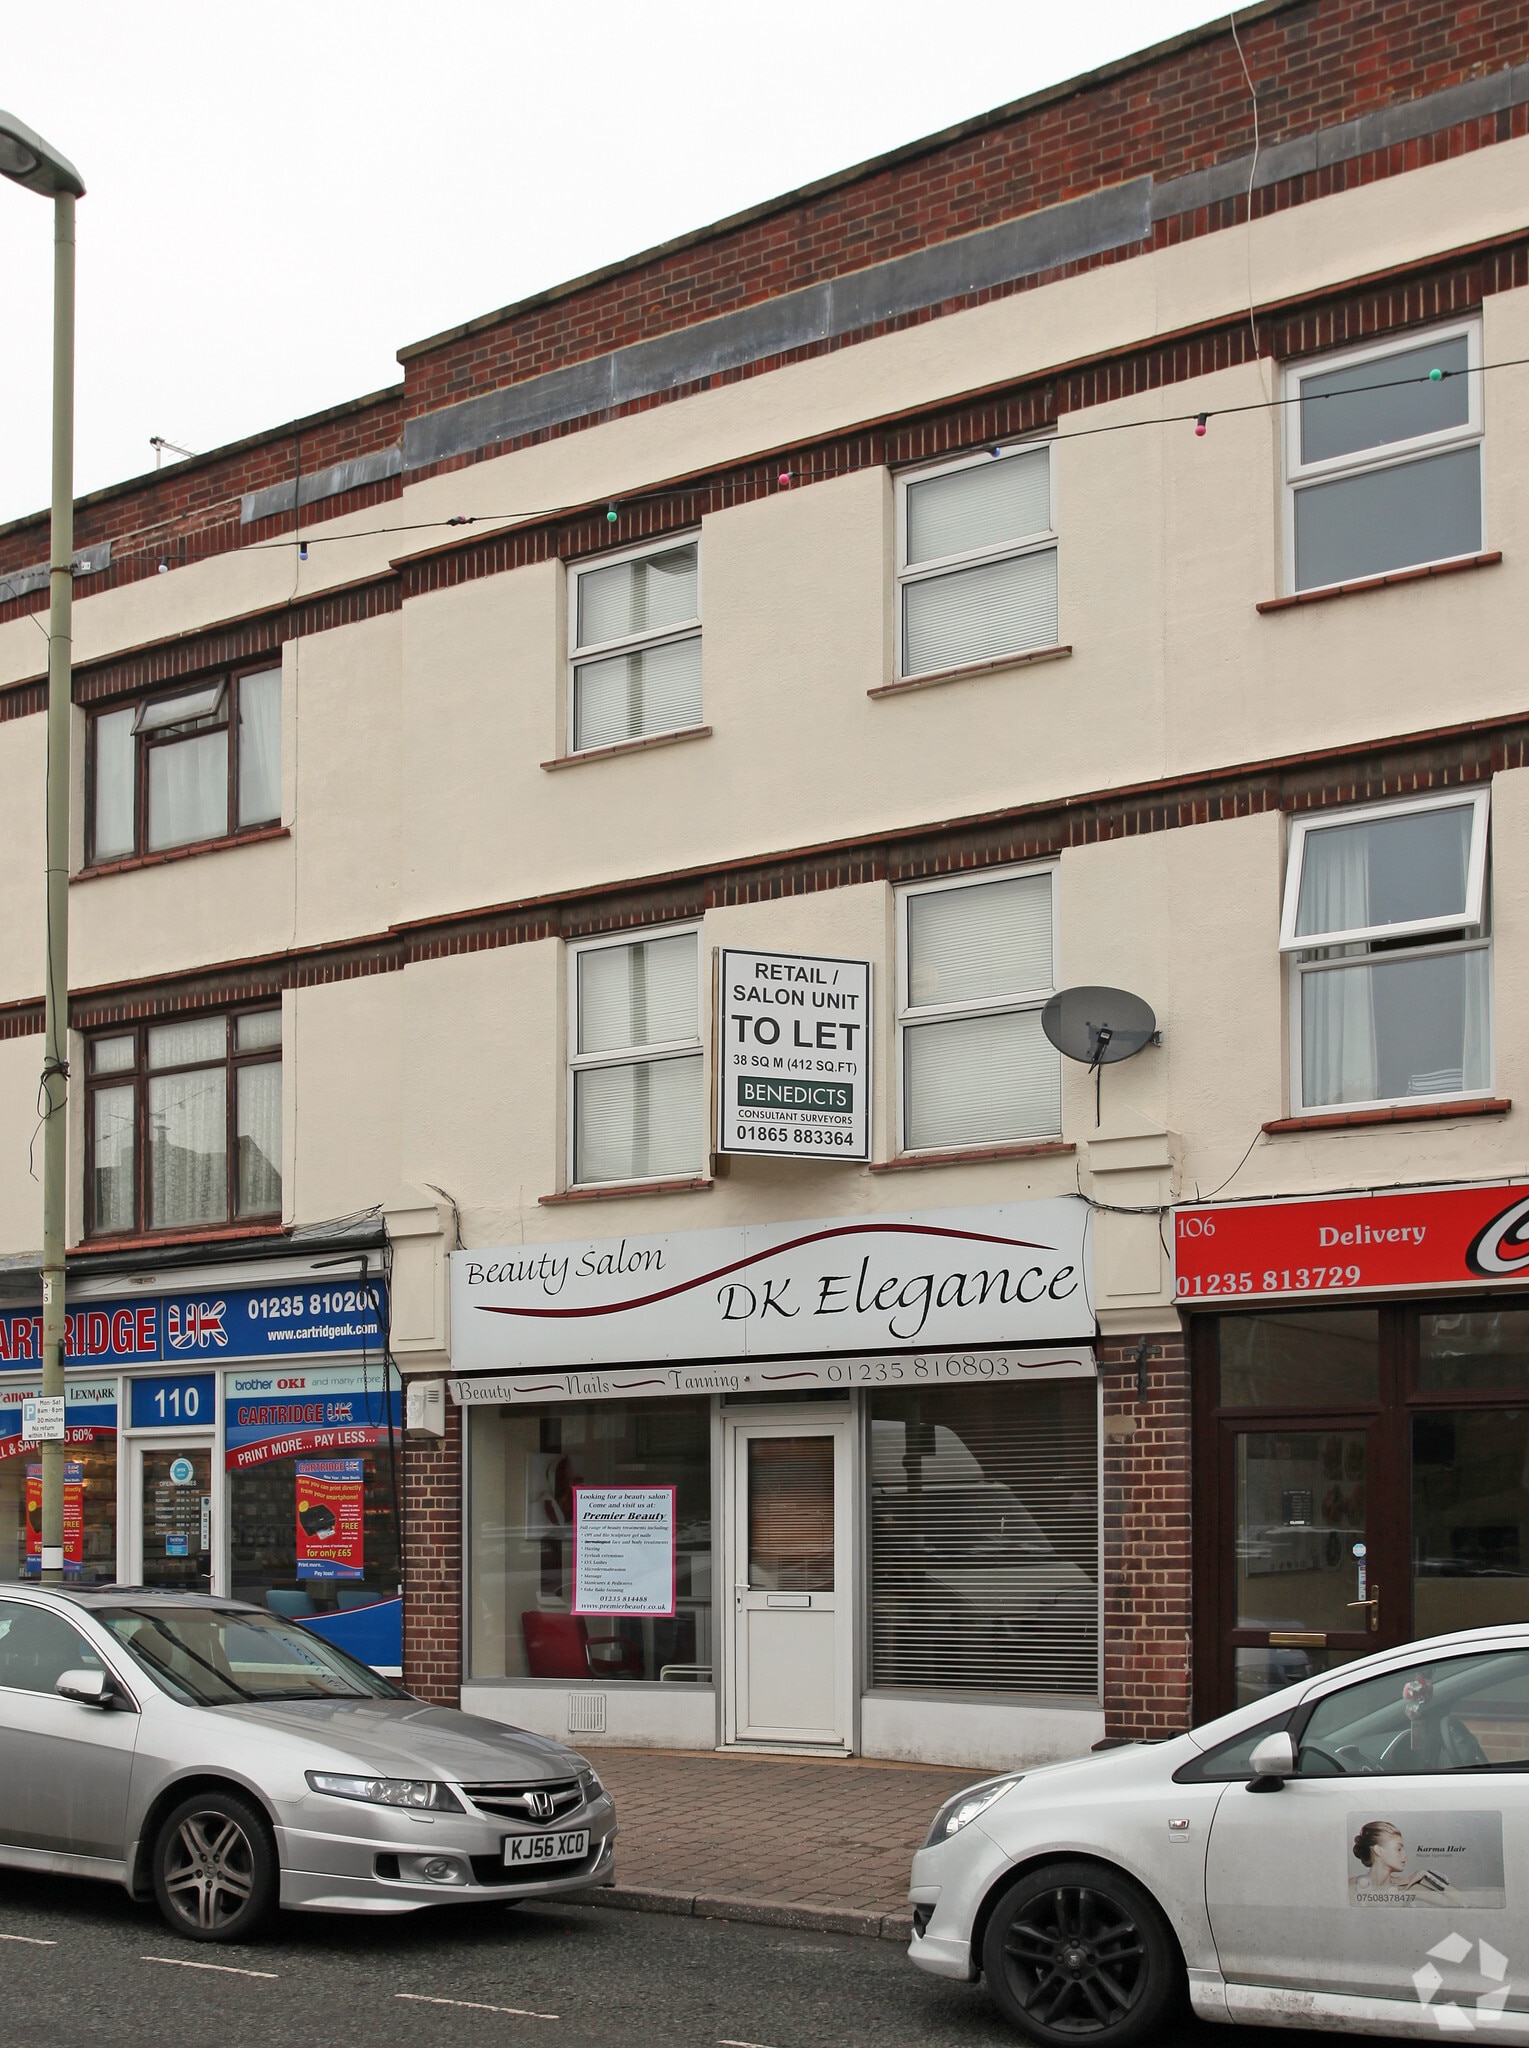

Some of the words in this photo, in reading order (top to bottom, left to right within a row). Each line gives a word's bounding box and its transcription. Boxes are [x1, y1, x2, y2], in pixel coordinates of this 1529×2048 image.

[755, 962, 827, 985] RETAIL
[832, 969, 839, 986] /
[733, 984, 805, 1007] SALON
[812, 991, 859, 1010] UNIT
[731, 1014, 781, 1045] TO
[793, 1020, 860, 1051] LET
[733, 1054, 747, 1066] 38
[751, 1055, 770, 1068] SQ
[773, 1057, 783, 1068] M
[787, 1058, 812, 1072] (412
[816, 1060, 857, 1076] SQ.FT)
[744, 1083, 847, 1106] BENEDICTS
[738, 1109, 798, 1122] CONSULTANT
[800, 1113, 853, 1125] SURVEYORS
[736, 1125, 788, 1142] 01865
[793, 1128, 854, 1147] 883364
[1178, 1216, 1216, 1239] 106
[1319, 1224, 1426, 1248] Delivery
[465, 1252, 569, 1296] Beauty
[575, 1239, 666, 1278] Salon
[1176, 1271, 1253, 1296] 01235
[1262, 1265, 1361, 1291] 813729
[248, 1295, 304, 1320] 01235
[309, 1288, 380, 1315] 810200
[716, 1278, 801, 1321] DK
[813, 1255, 1079, 1339] Elegance
[168, 1300, 228, 1350] UK
[267, 1323, 378, 1342] www.cartridgeuk.com
[235, 1378, 273, 1391] brother
[277, 1377, 306, 1389] OKI
[311, 1376, 329, 1386] and
[331, 1376, 355, 1387] many
[455, 1380, 512, 1402] Beauty
[565, 1373, 610, 1396] Nails
[668, 1370, 739, 1391] Tanning
[827, 1362, 904, 1383] 01235
[914, 1354, 1010, 1380] 816893
[70, 1388, 115, 1401] LEXMARK
[154, 1386, 200, 1418] 110
[26, 1405, 35, 1420] P
[238, 1404, 324, 1425] CARTRIDGE
[327, 1402, 353, 1422] UK
[9, 1443, 17, 1455] &
[73, 1429, 94, 1442] 60%
[237, 1445, 268, 1466] PRINT
[271, 1437, 312, 1455] MORE...
[314, 1433, 335, 1447] PAY
[337, 1430, 376, 1445] LESS...
[298, 1461, 344, 1473] CARTRIDGE
[313, 1491, 326, 1499] your
[342, 1484, 362, 1492] directly
[580, 1493, 606, 1501] Looking
[606, 1493, 617, 1501] for
[341, 1522, 359, 1530] FREE
[582, 1511, 625, 1520] Premier
[627, 1511, 667, 1522] Beauty
[307, 1549, 318, 1557] for
[319, 1549, 336, 1558] only
[337, 1549, 352, 1557] £65
[511, 1837, 554, 1860] KJ56
[557, 1833, 584, 1856] XCO
[1356, 1893, 1416, 1902] 07508378477
